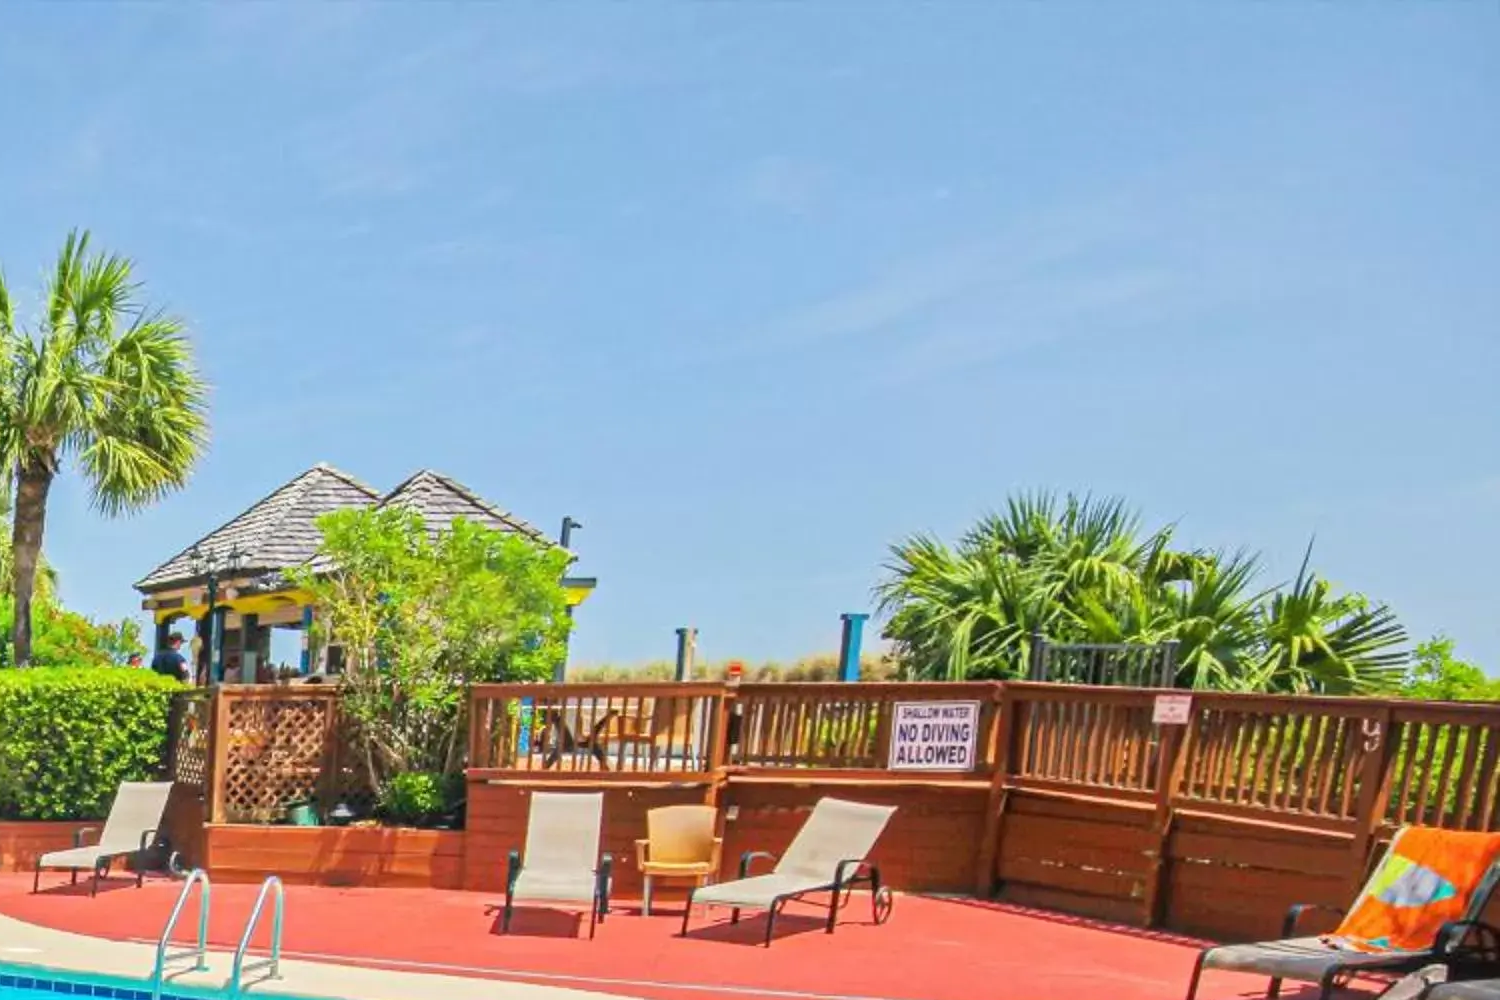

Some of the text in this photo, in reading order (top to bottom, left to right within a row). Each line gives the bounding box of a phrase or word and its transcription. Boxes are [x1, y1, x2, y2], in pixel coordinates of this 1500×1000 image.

[902, 706, 971, 719] SHALLOW WATER
[898, 723, 970, 742] NO DIVING
[897, 745, 967, 763] ALLOWED
